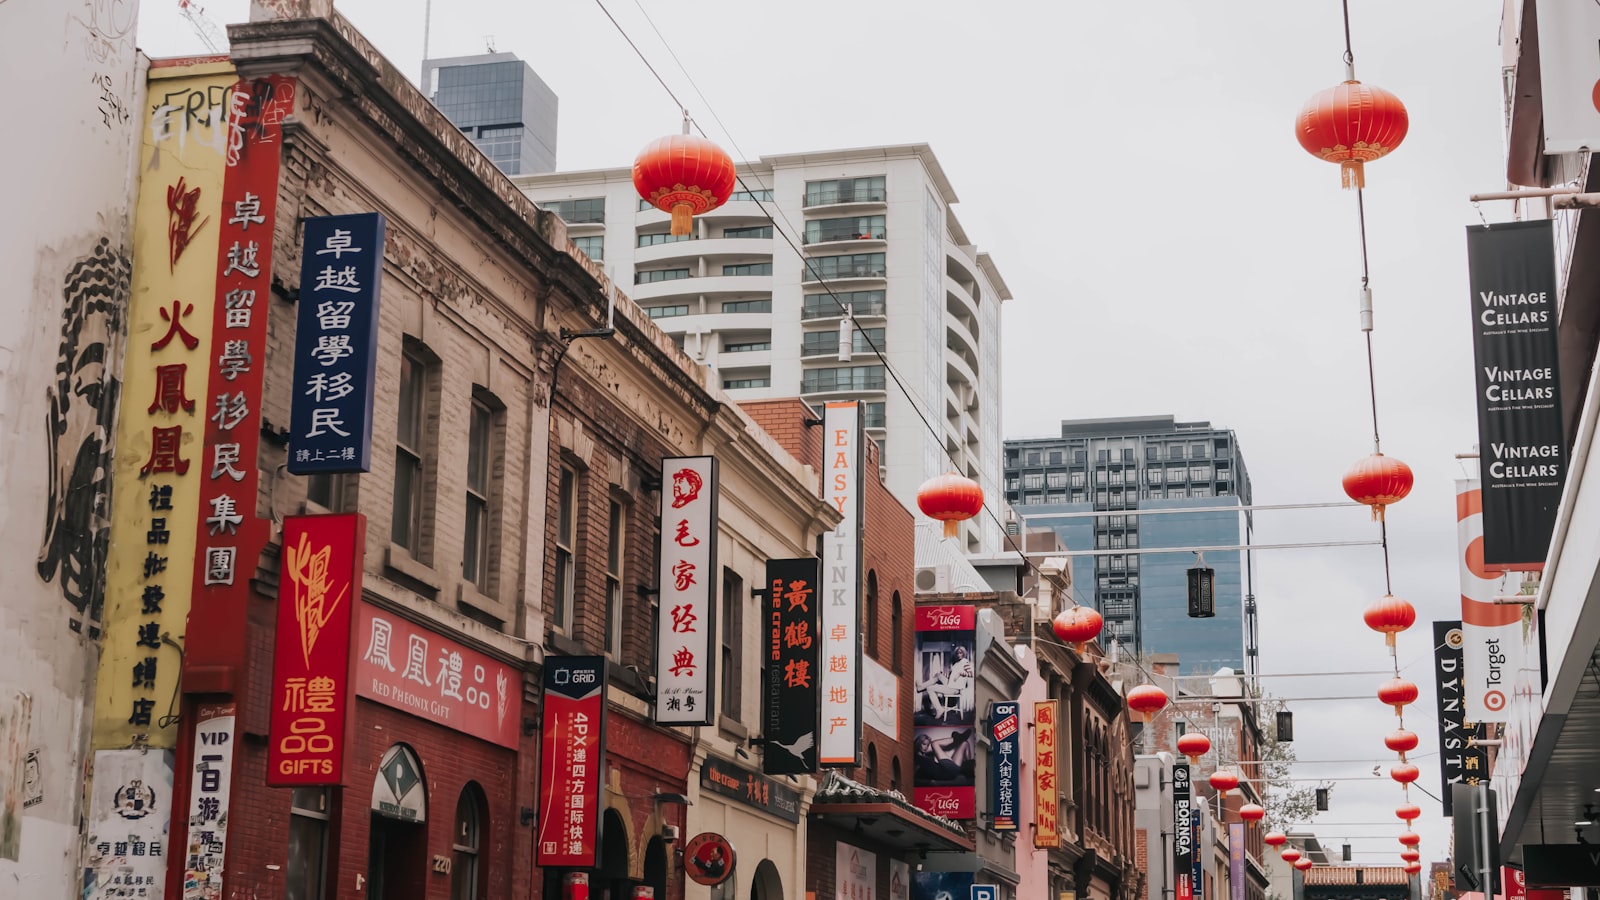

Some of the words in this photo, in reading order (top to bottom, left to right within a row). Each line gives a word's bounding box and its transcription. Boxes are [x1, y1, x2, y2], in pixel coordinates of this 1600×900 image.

[305, 229, 362, 438] 卓越留學移民
[141, 300, 199, 476] 火鳳凰
[203, 192, 266, 586] 卓越留學移民集團
[296, 447, 356, 462] 請上二樓
[667, 519, 700, 678] 毛家经典
[772, 578, 782, 608] the
[771, 612, 781, 661] crane
[364, 617, 490, 709] 鳳凰禮品
[572, 674, 595, 683] GRID
[829, 624, 848, 735] 卓越地产
[1485, 638, 1506, 688] Target
[279, 675, 336, 753] 禮品
[372, 678, 390, 697] RED
[392, 685, 429, 712] PHEONIX
[430, 701, 450, 719] GIFT
[771, 665, 780, 731] restaurant
[200, 731, 229, 745] VIP
[997, 717, 1015, 731] DUTY
[998, 725, 1016, 739] FREE
[279, 759, 333, 775] GIFTS
[569, 712, 588, 855] 4PX递四方国际快递
[1039, 813, 1055, 833] NAN
[1178, 800, 1191, 855] BORNGA
[434, 855, 452, 874] 220
